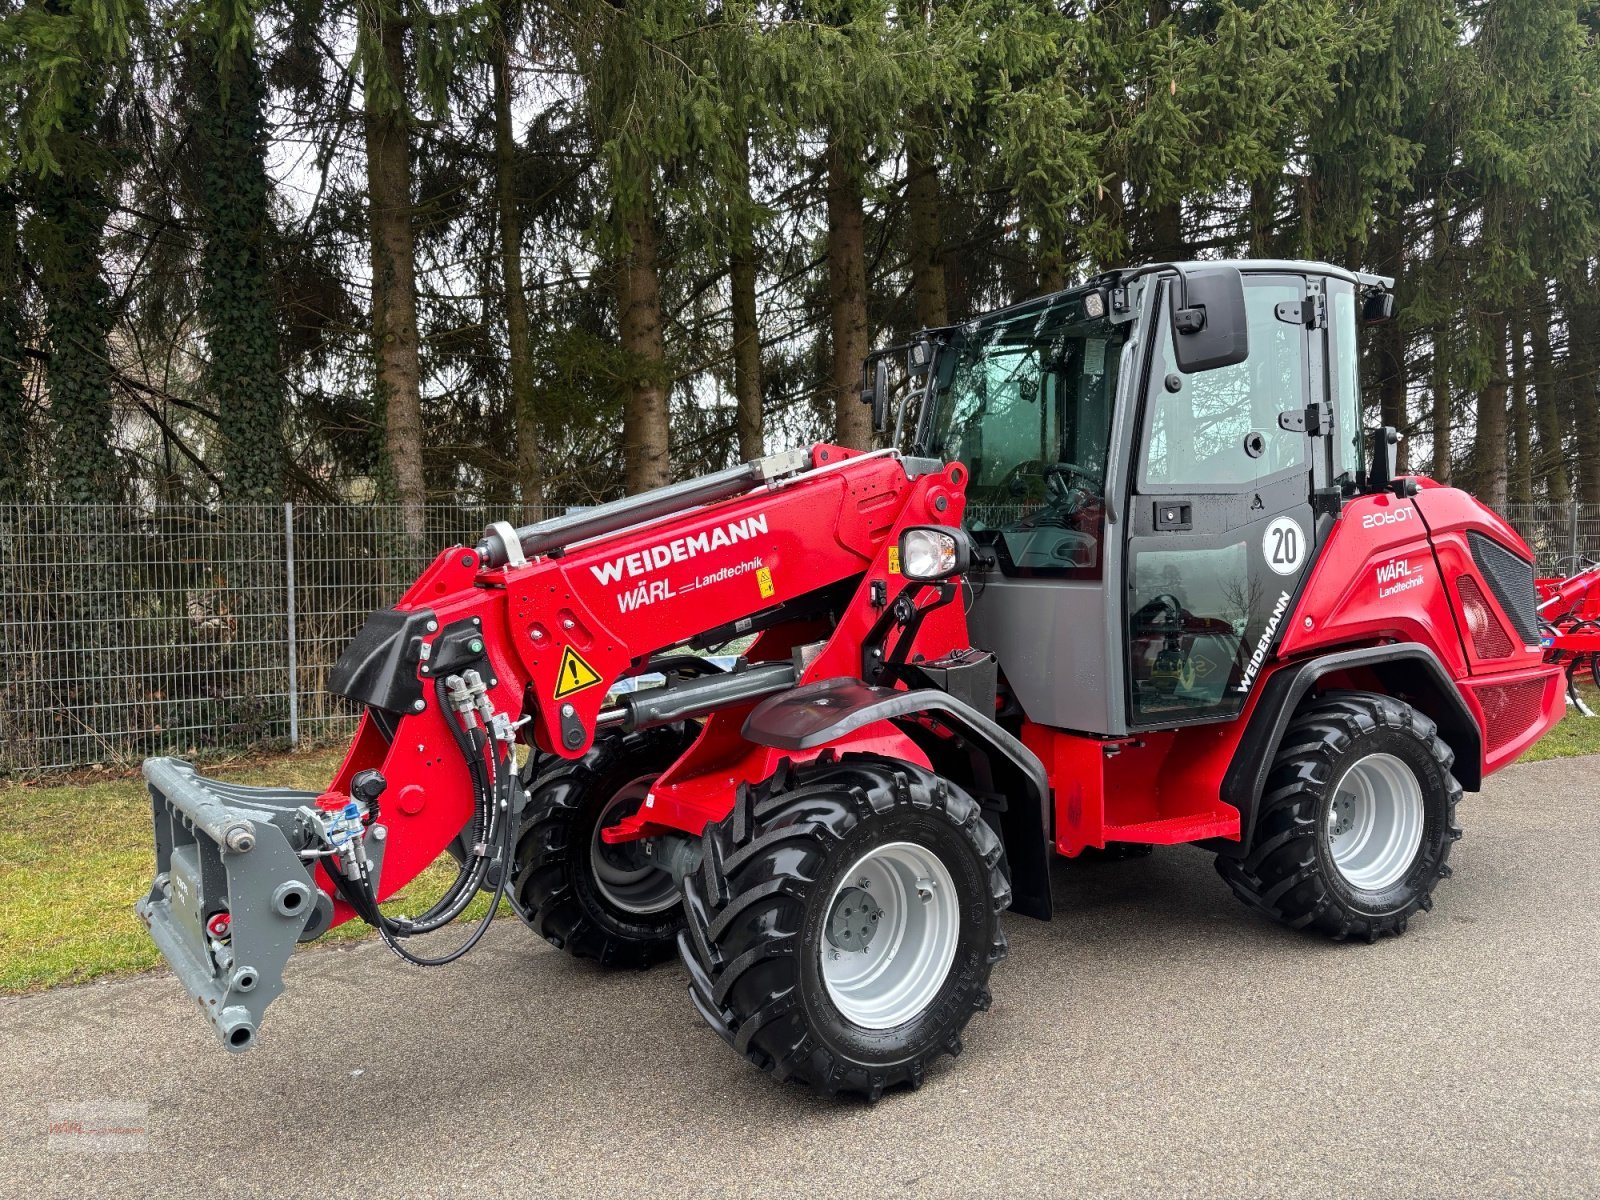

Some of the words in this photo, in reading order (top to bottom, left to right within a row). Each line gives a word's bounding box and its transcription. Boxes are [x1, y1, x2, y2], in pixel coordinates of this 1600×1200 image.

[590, 513, 768, 586] WEIDEMANN
[1271, 527, 1297, 564] 20
[617, 578, 677, 613] WÄRL
[695, 556, 763, 588] Landtechnik
[1376, 559, 1412, 584] WÄRL
[1379, 575, 1424, 599] Landtechnik
[1237, 590, 1291, 693] WEIDEMANN
